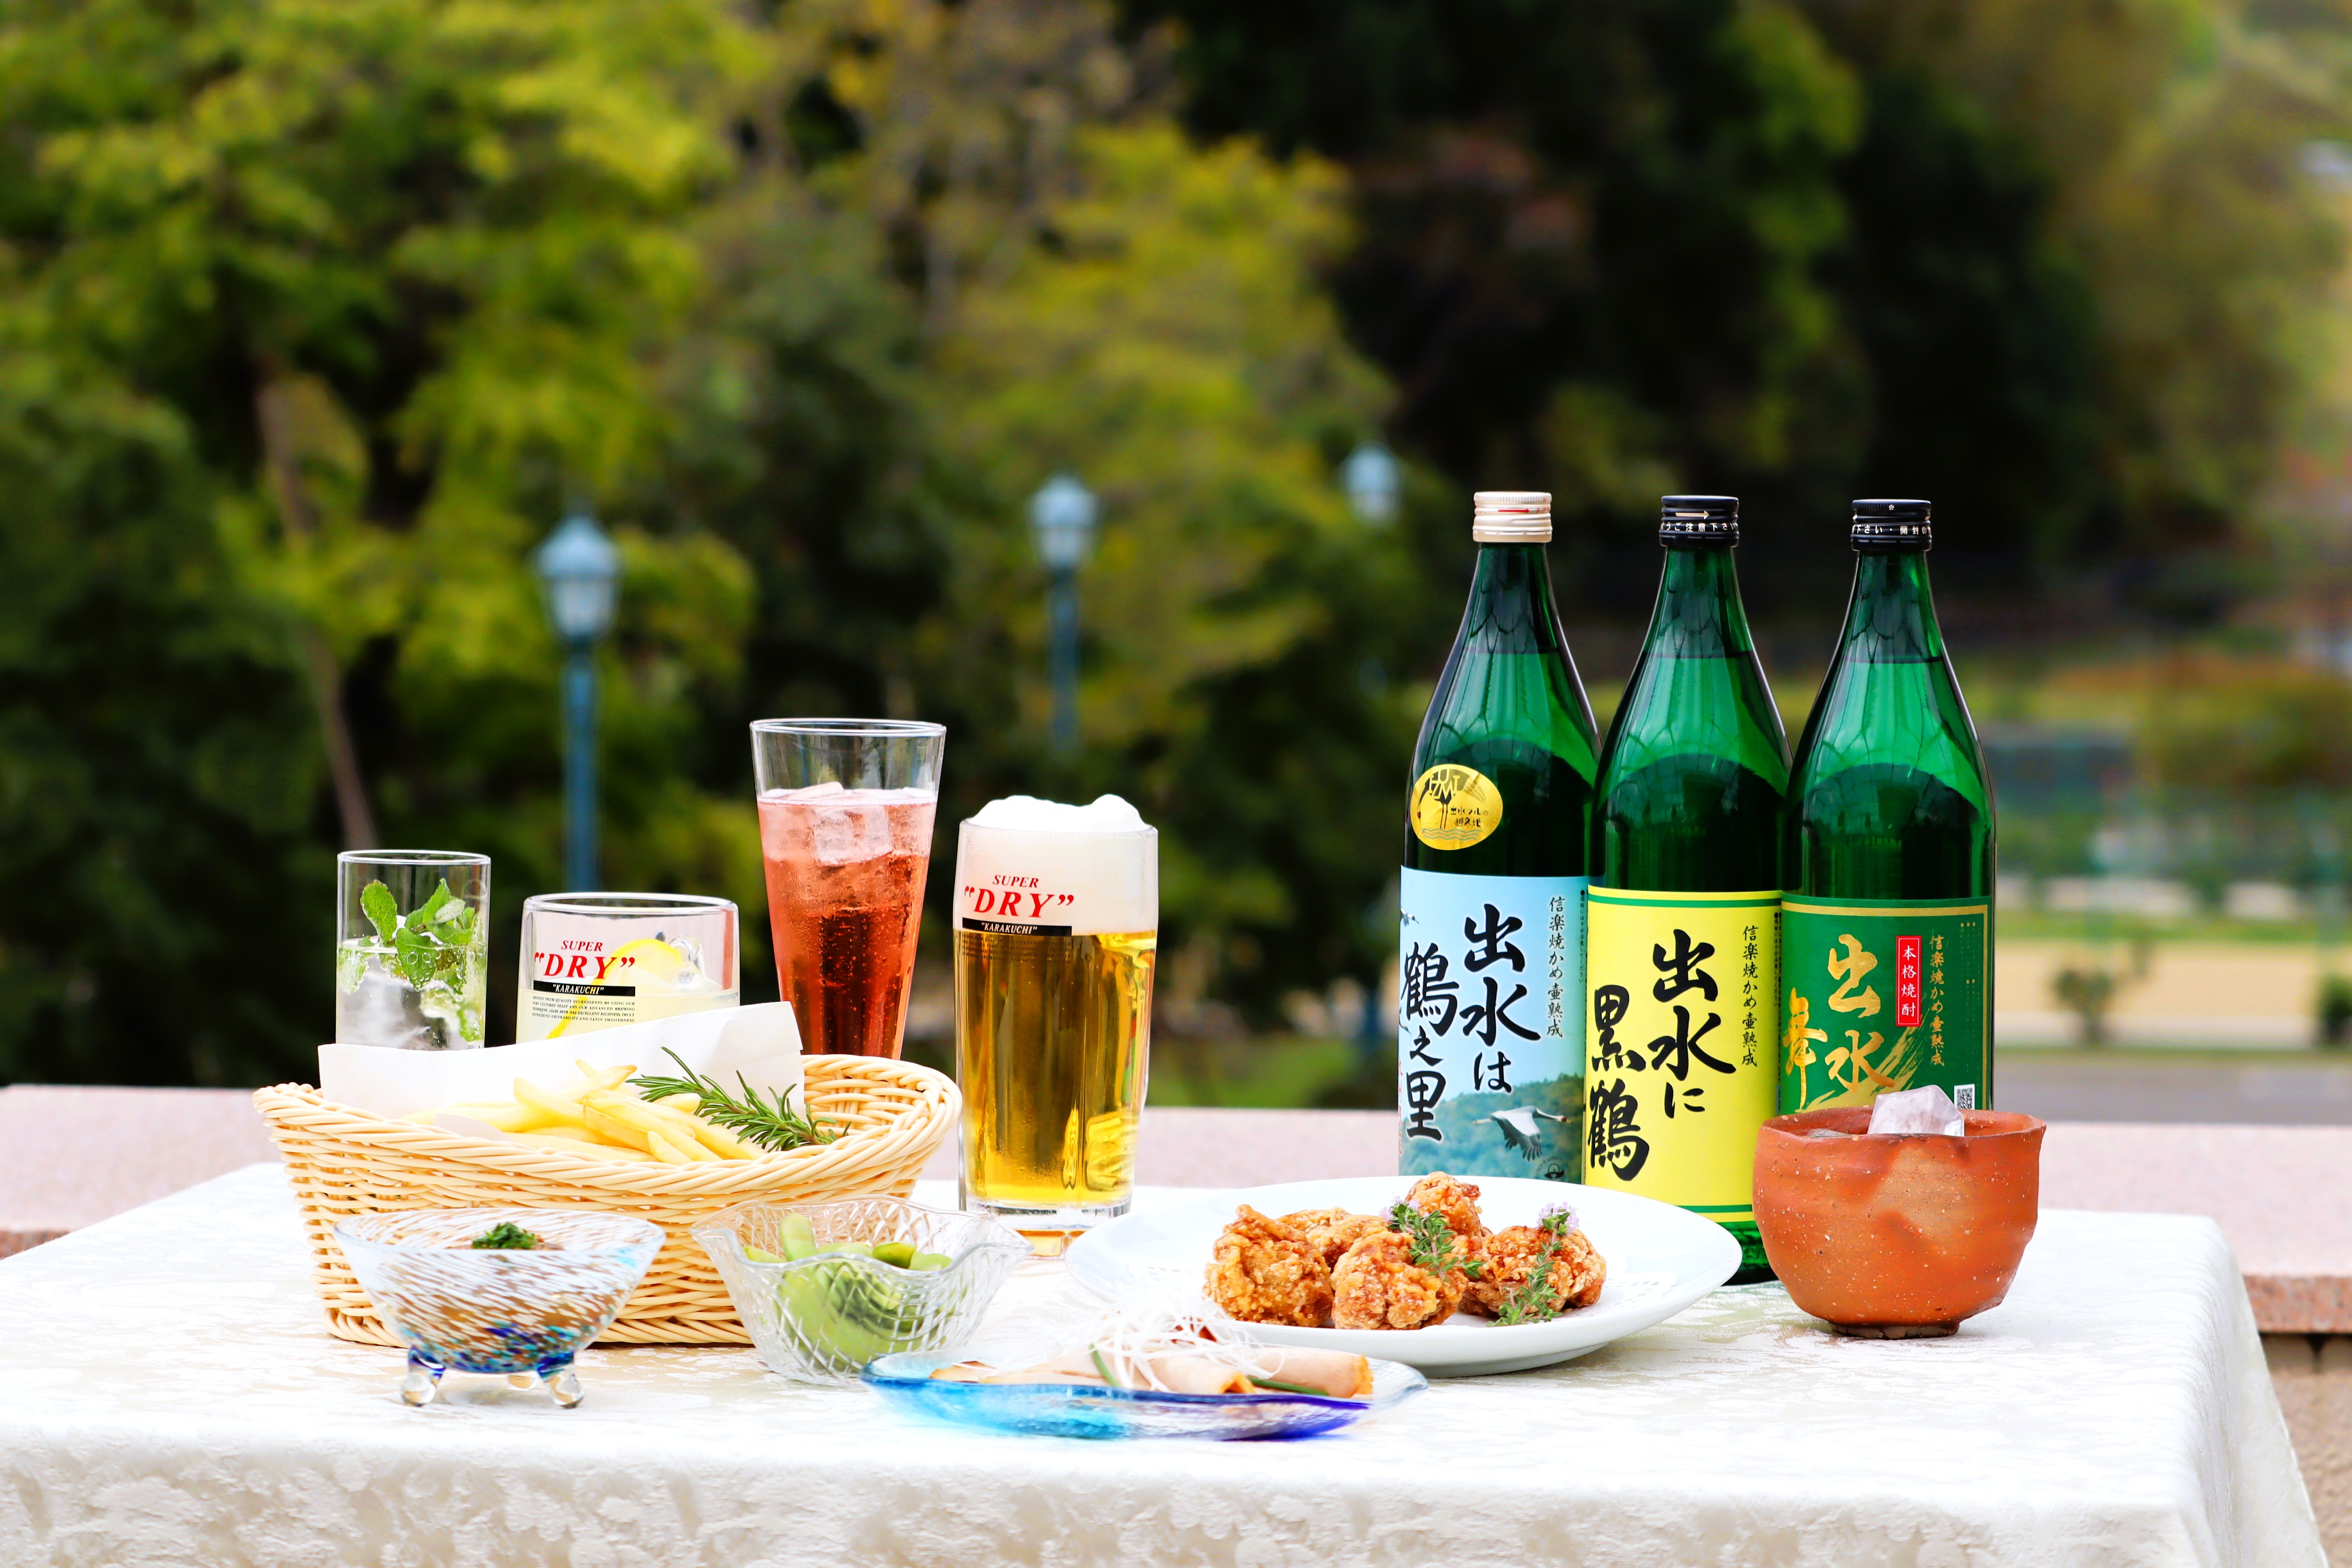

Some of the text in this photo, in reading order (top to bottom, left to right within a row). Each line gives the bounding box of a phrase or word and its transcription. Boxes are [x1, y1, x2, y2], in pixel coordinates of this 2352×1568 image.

[561, 940, 603, 952] SUPER
[992, 875, 1039, 888] SUPER
[1400, 942, 1459, 1141] 鶴之里
[1459, 904, 1541, 1093] 出水は
[1647, 929, 1736, 1119] 出水に
[1900, 945, 1917, 1017] 本格焼酎
[1587, 985, 1649, 1181] 黒鶴
